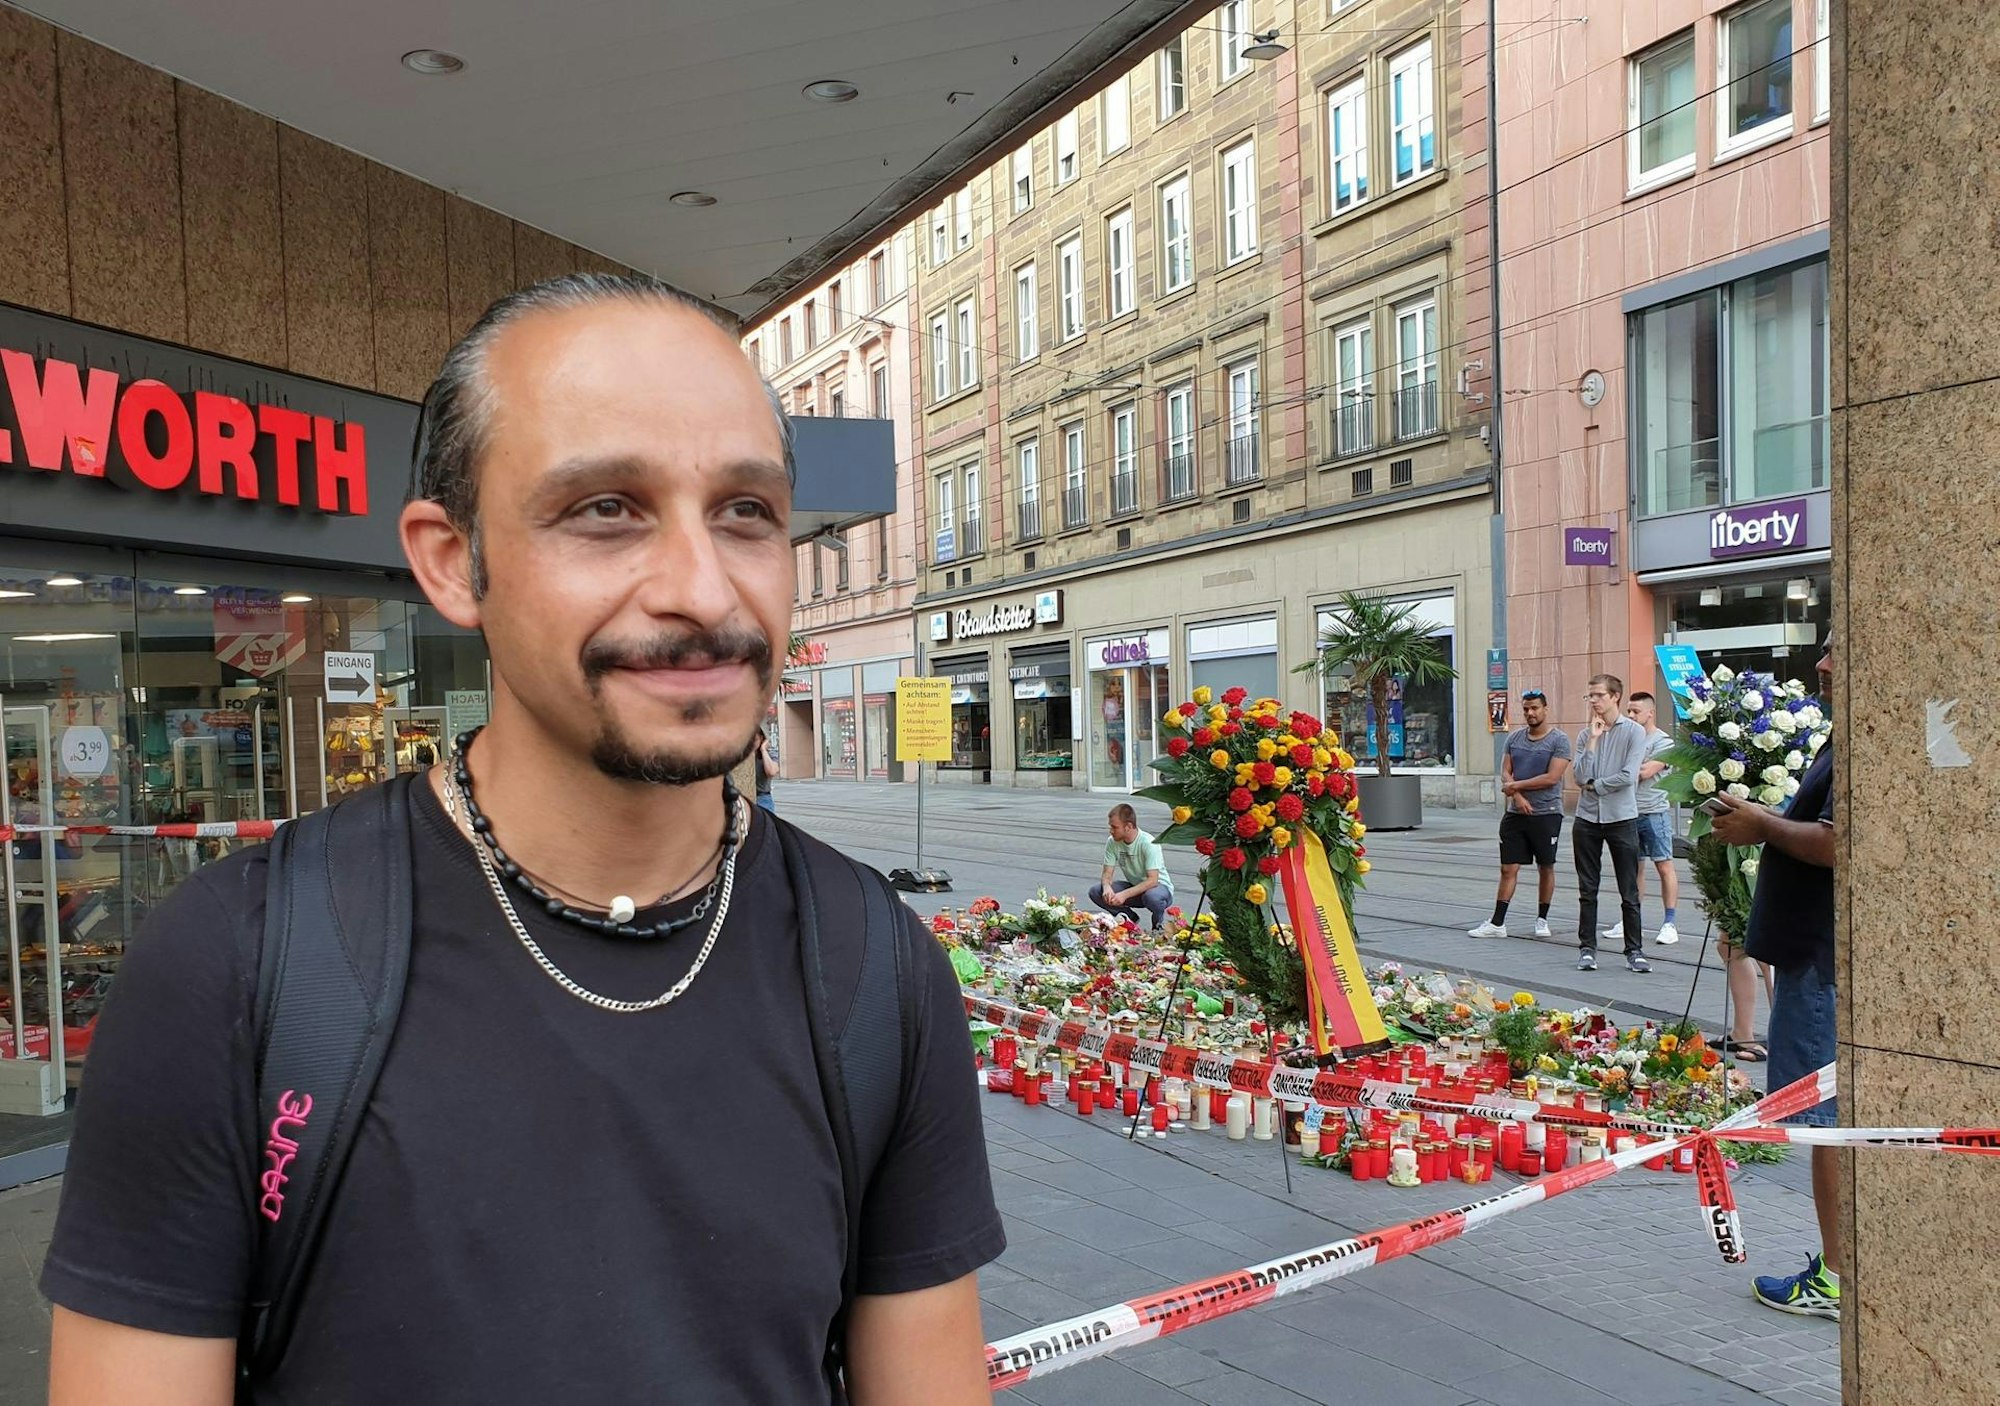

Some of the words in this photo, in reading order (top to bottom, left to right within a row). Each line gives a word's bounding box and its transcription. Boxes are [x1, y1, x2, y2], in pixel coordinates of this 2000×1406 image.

[1711, 510, 1800, 548] liberty
[1573, 537, 1608, 555] liberty
[955, 604, 1032, 639] Brandstetter
[328, 657, 372, 668] EINGANG
[900, 680, 946, 689] Gemeinsam
[906, 690, 941, 699] achtsam:
[1329, 963, 1353, 996] STADT
[259, 1089, 314, 1222] DAKINE
